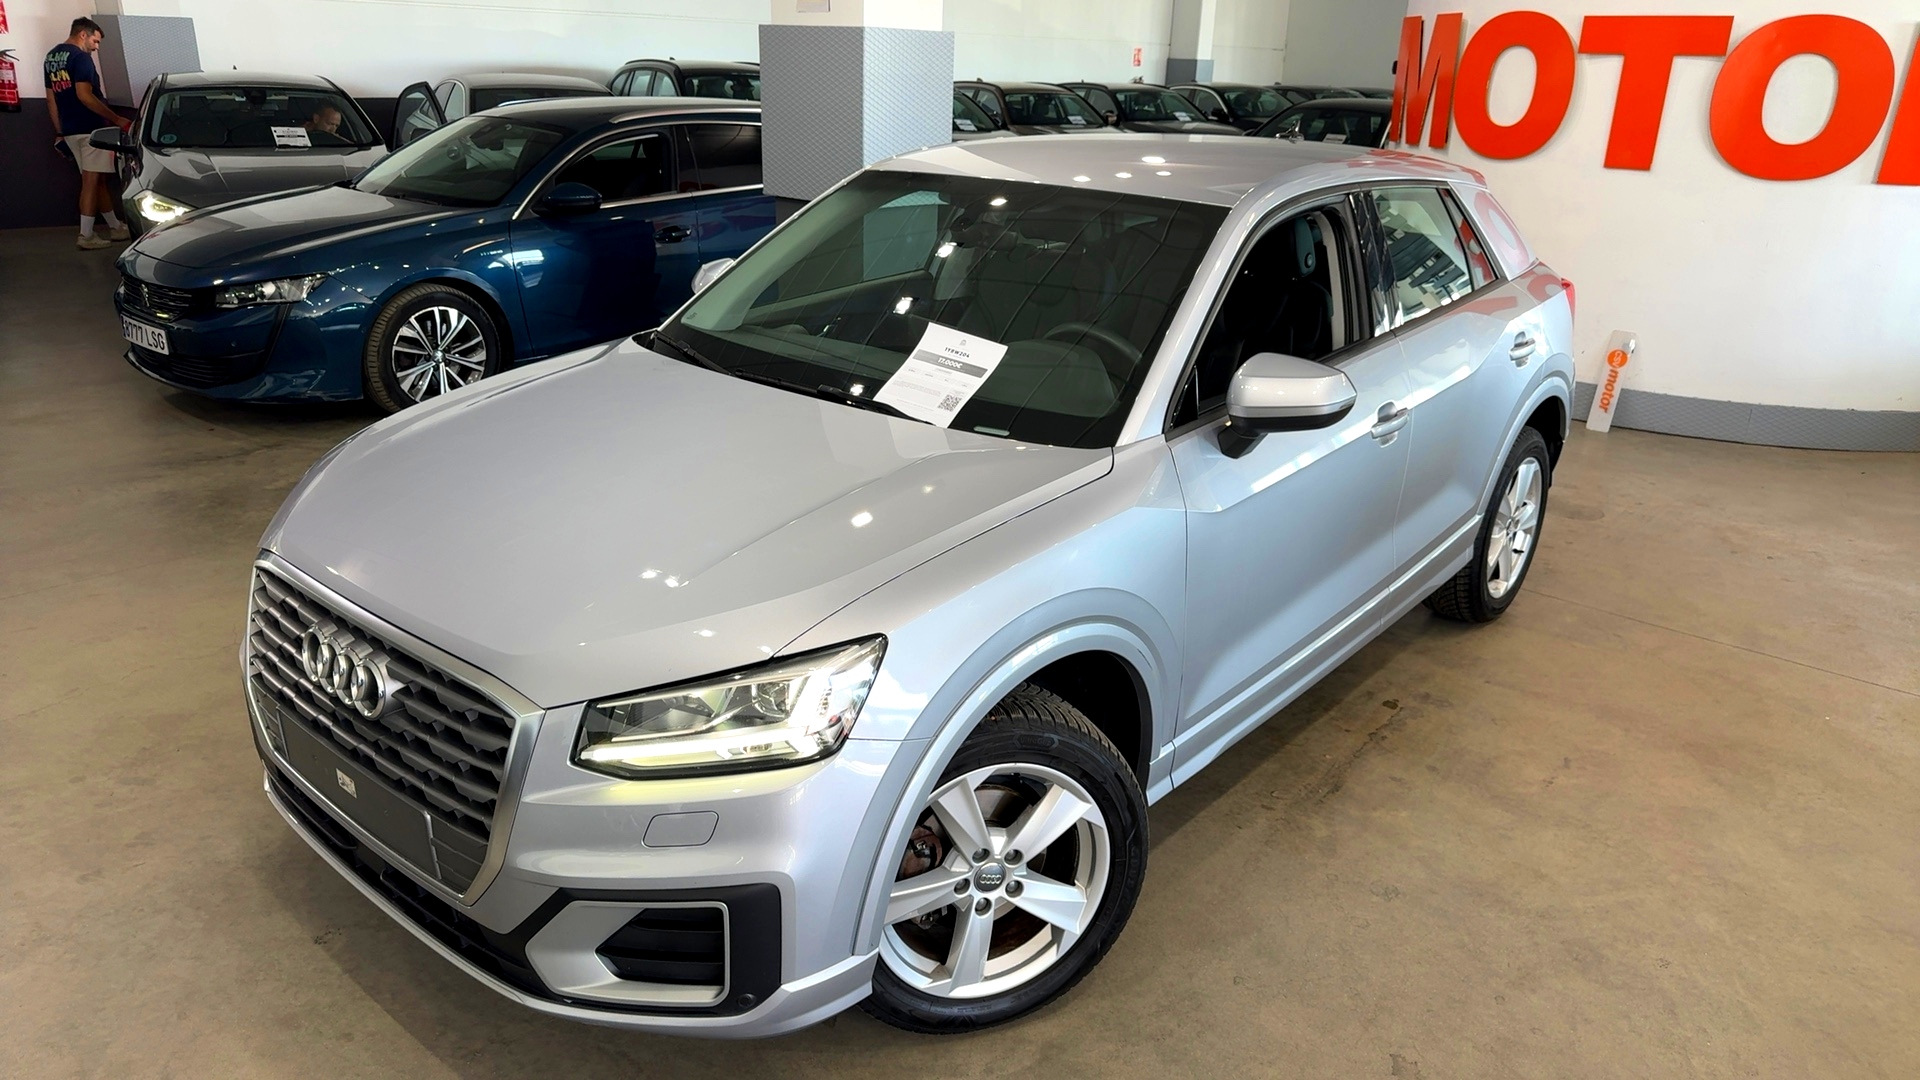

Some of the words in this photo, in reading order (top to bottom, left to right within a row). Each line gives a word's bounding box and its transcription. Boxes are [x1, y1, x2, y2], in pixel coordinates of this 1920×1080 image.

[123, 319, 144, 344] 8777
[145, 328, 165, 351] LSG
[1599, 368, 1619, 414] motor
